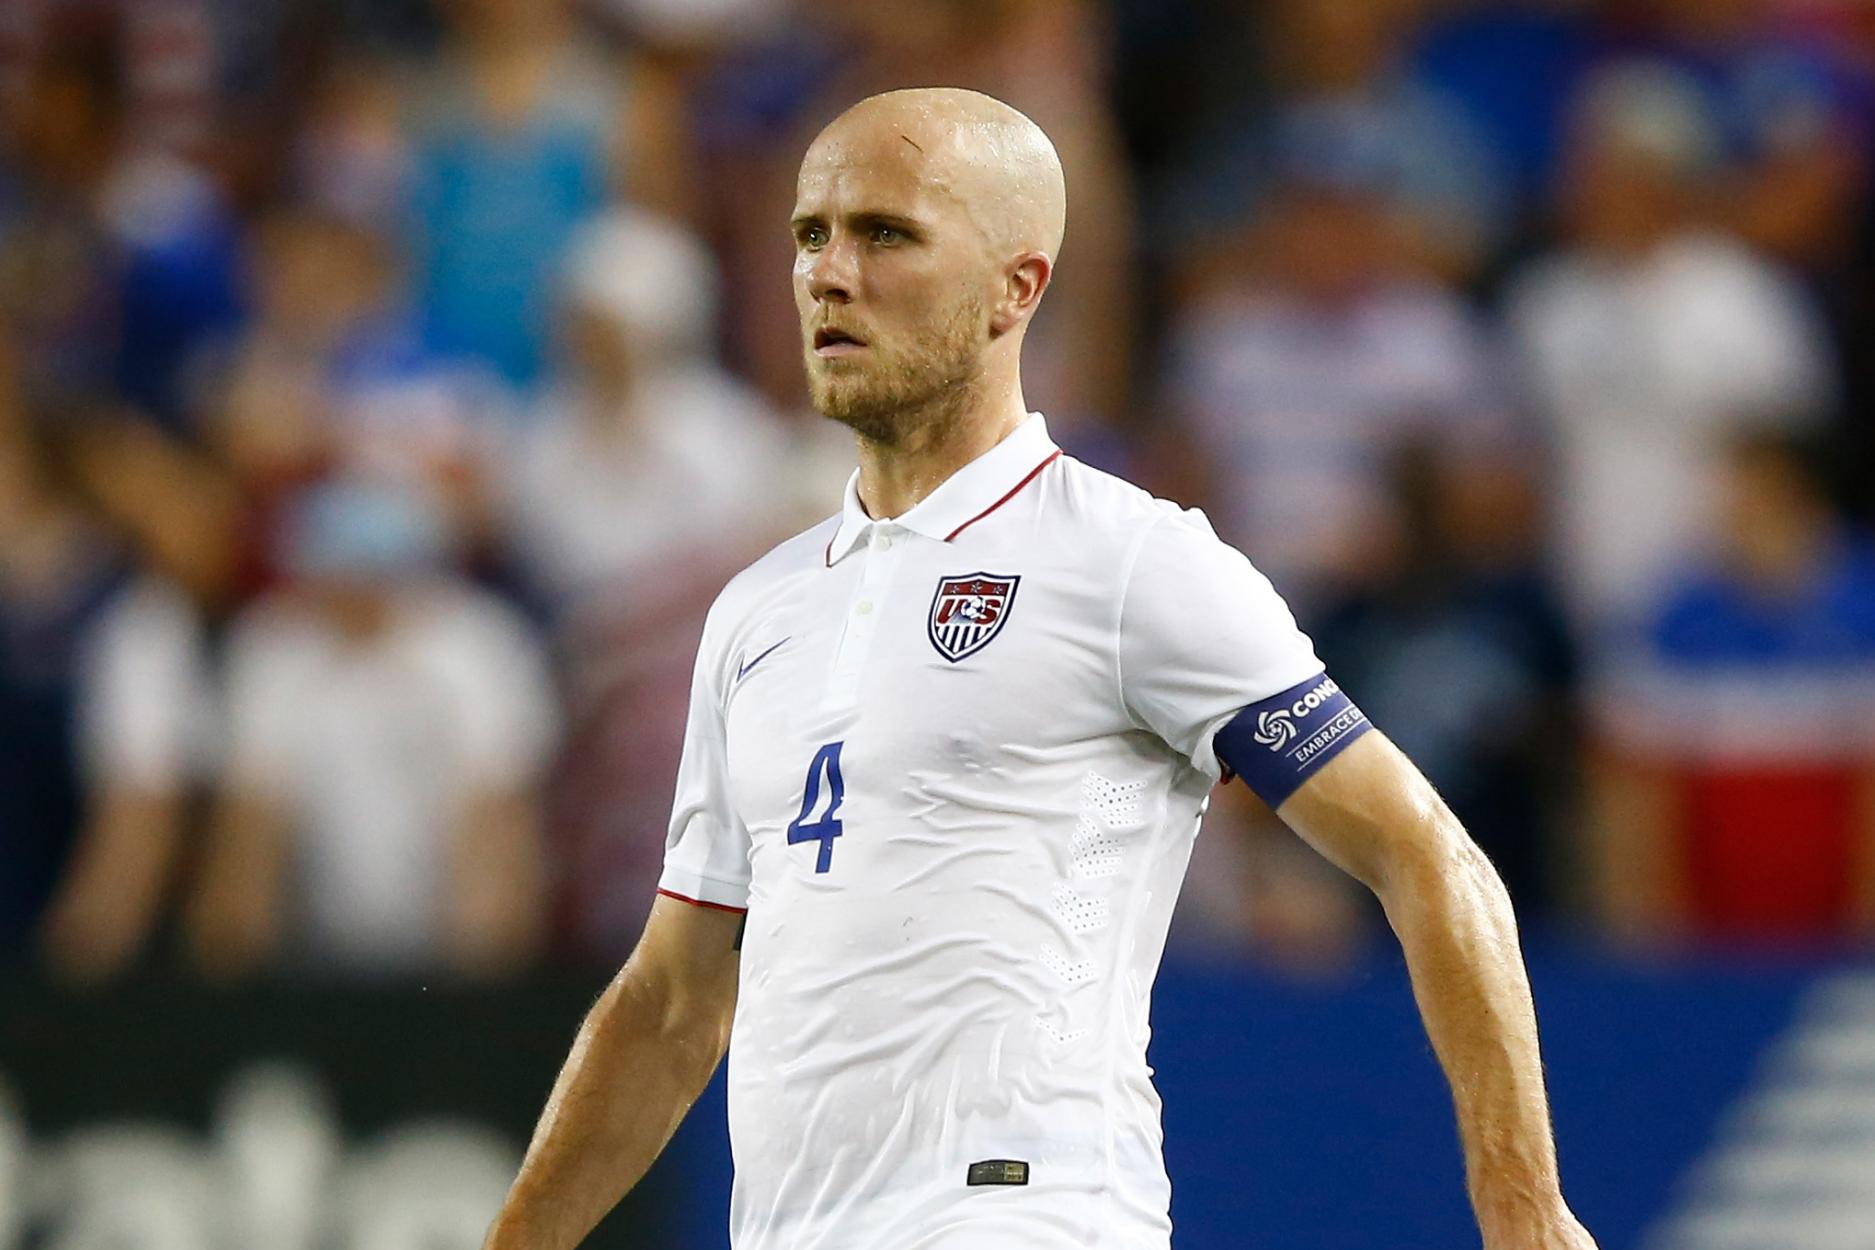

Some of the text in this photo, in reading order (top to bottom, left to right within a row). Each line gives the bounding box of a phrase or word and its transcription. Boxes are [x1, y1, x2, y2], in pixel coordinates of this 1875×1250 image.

[936, 599, 1001, 625] US
[1295, 713, 1353, 762] EMBRACE
[787, 740, 845, 874] 4
